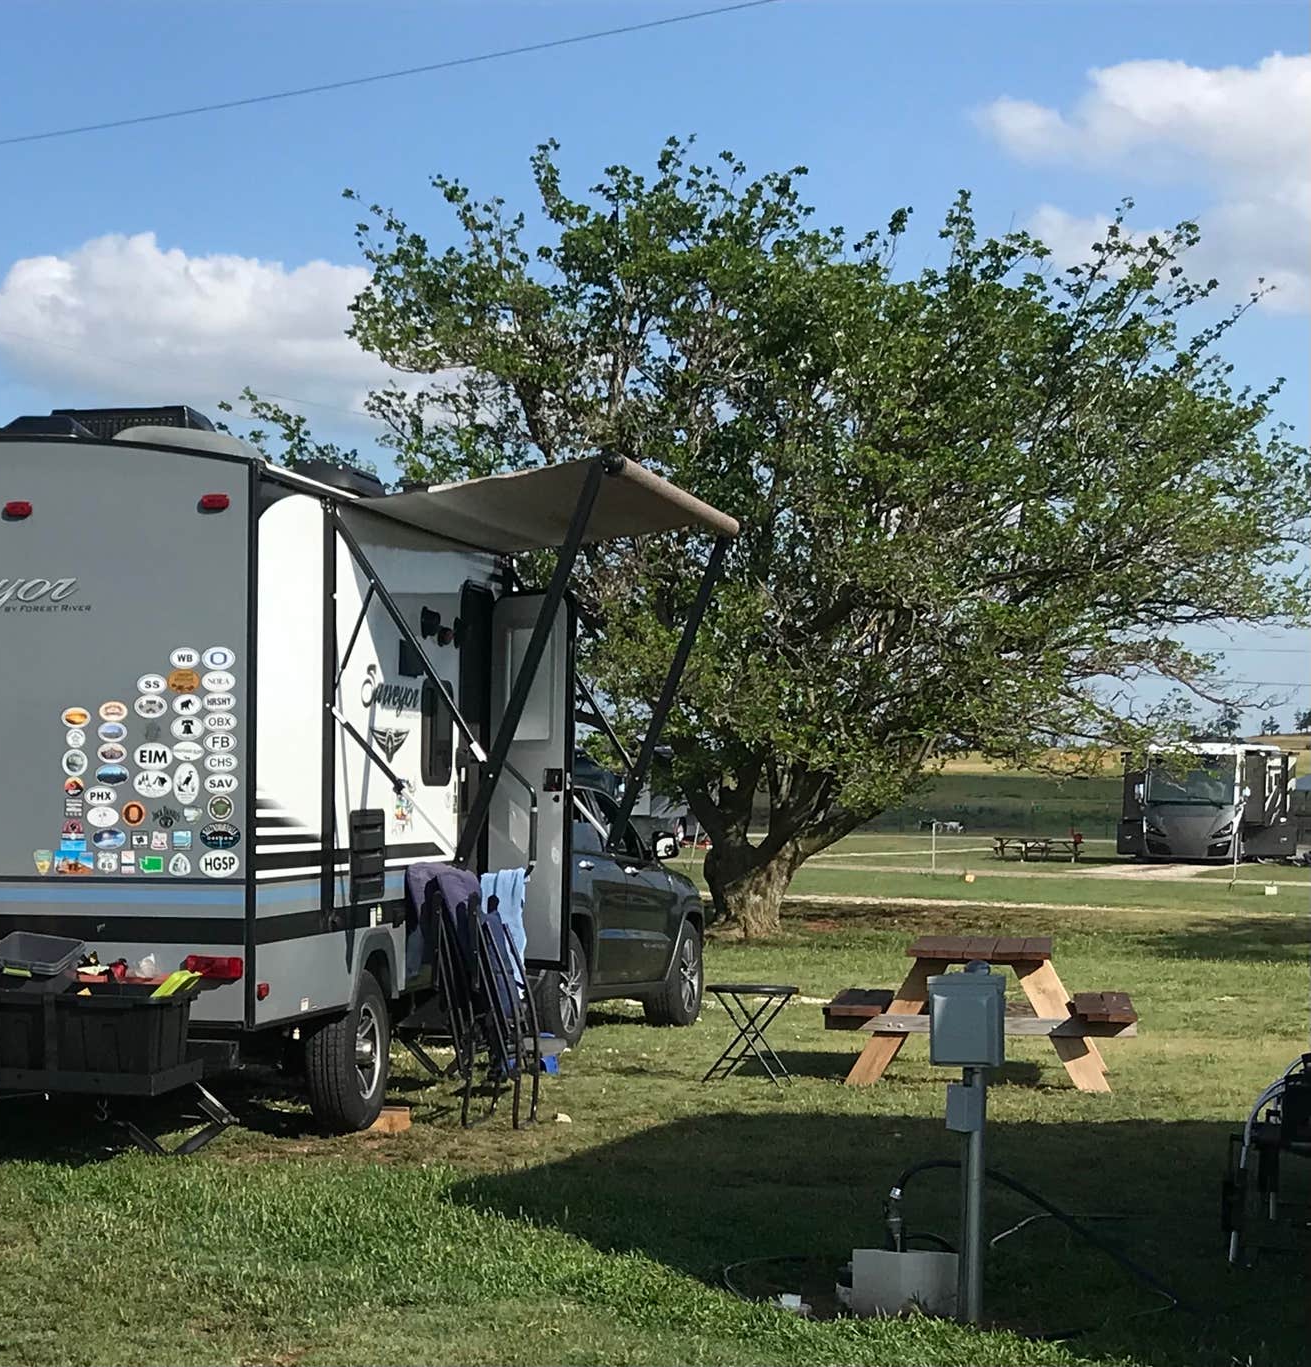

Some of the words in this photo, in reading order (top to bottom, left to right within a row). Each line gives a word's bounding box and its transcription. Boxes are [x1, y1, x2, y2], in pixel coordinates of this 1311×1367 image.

[3, 605, 18, 613] BY
[19, 605, 59, 613] FOREST
[60, 604, 91, 613] RIVER
[177, 654, 193, 663] WB
[144, 680, 161, 689] SS
[208, 717, 232, 727] OBX
[212, 737, 231, 748] FB
[139, 750, 168, 764] EIM
[209, 757, 233, 767] CHS
[208, 778, 234, 789] SAV
[89, 791, 112, 801] PHX
[204, 856, 236, 871] HGSP
